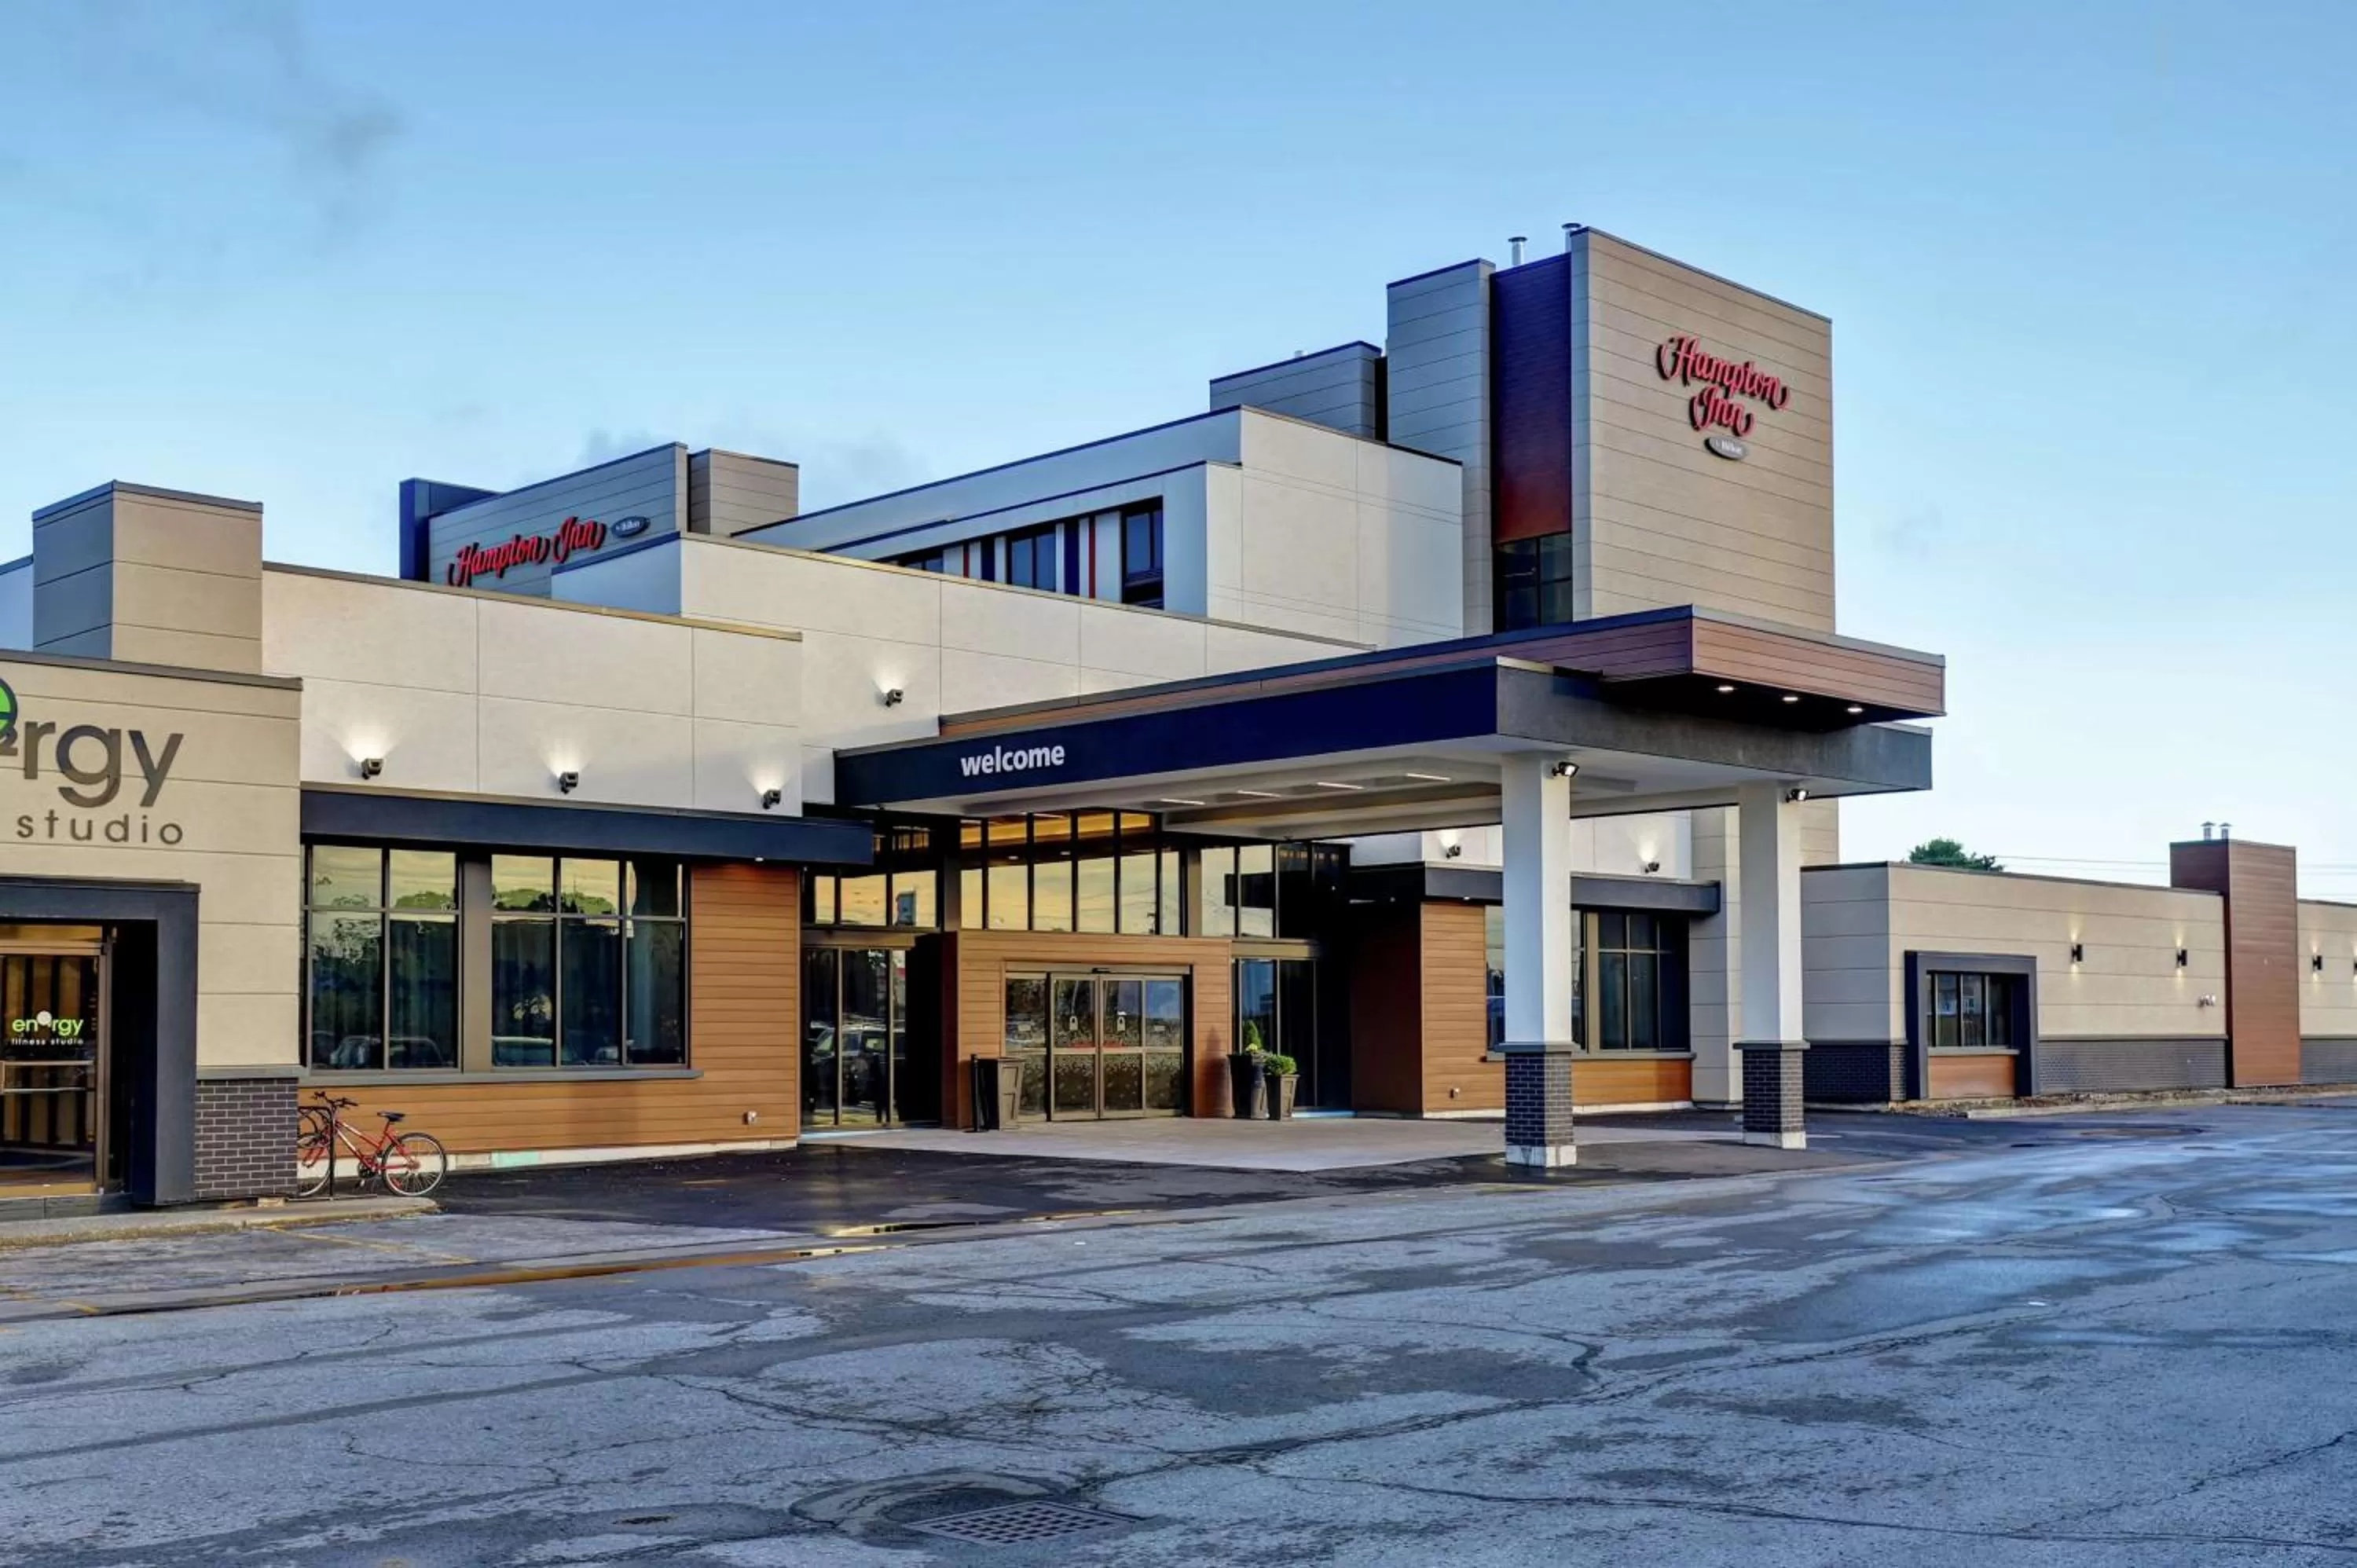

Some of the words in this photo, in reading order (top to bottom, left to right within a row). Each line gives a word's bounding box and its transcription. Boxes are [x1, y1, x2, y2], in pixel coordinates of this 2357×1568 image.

[1656, 335, 1791, 410] Hampton
[1689, 385, 1756, 437] Inn
[447, 534, 550, 587] Hampton
[552, 516, 607, 563] Inn
[960, 746, 1065, 777] welcome
[16, 809, 183, 844] studio
